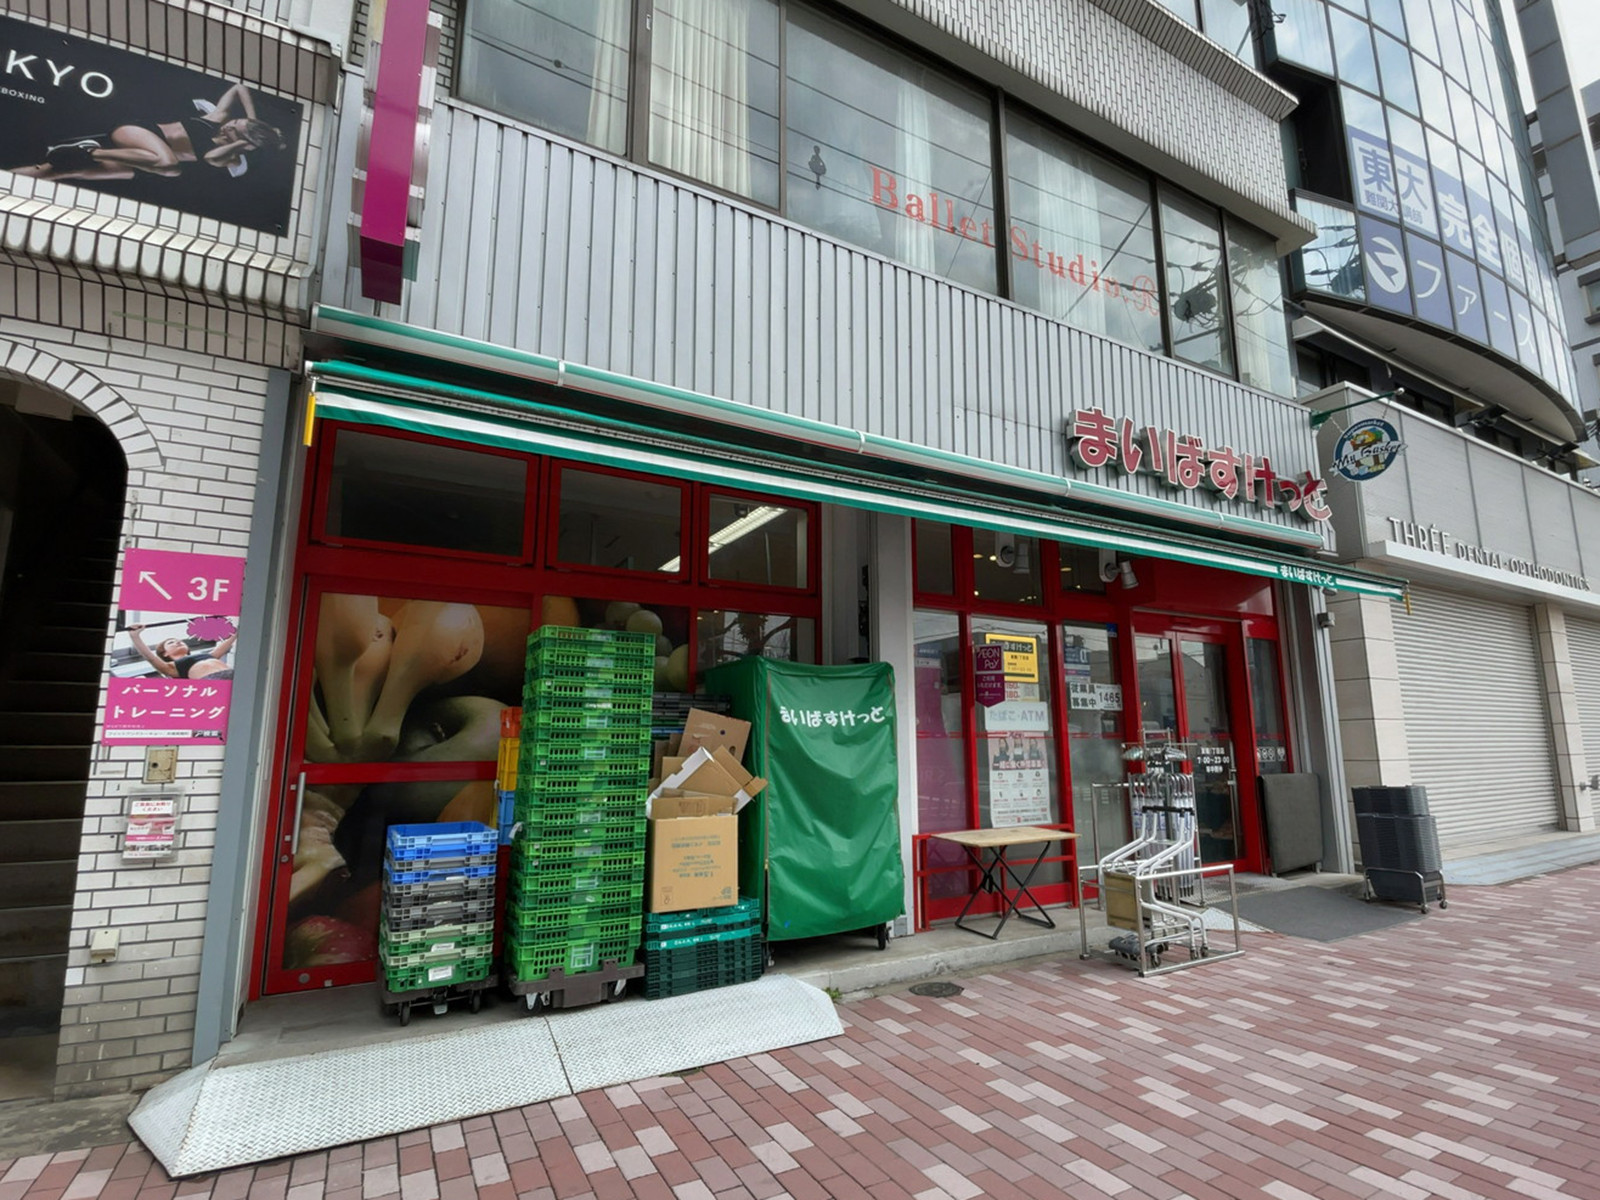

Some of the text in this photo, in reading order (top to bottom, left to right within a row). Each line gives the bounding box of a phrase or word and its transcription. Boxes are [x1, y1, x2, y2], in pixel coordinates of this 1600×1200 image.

[5, 49, 114, 99] KYO
[1, 87, 45, 104] BOXING
[1358, 146, 1429, 211] 東大
[868, 165, 996, 249] Ballet
[1072, 406, 1333, 522] まいばすけっと
[1279, 564, 1335, 587] まいばすけっと
[187, 576, 230, 602] 3F
[121, 684, 218, 698] パーソナル
[113, 705, 226, 720] トレーニング
